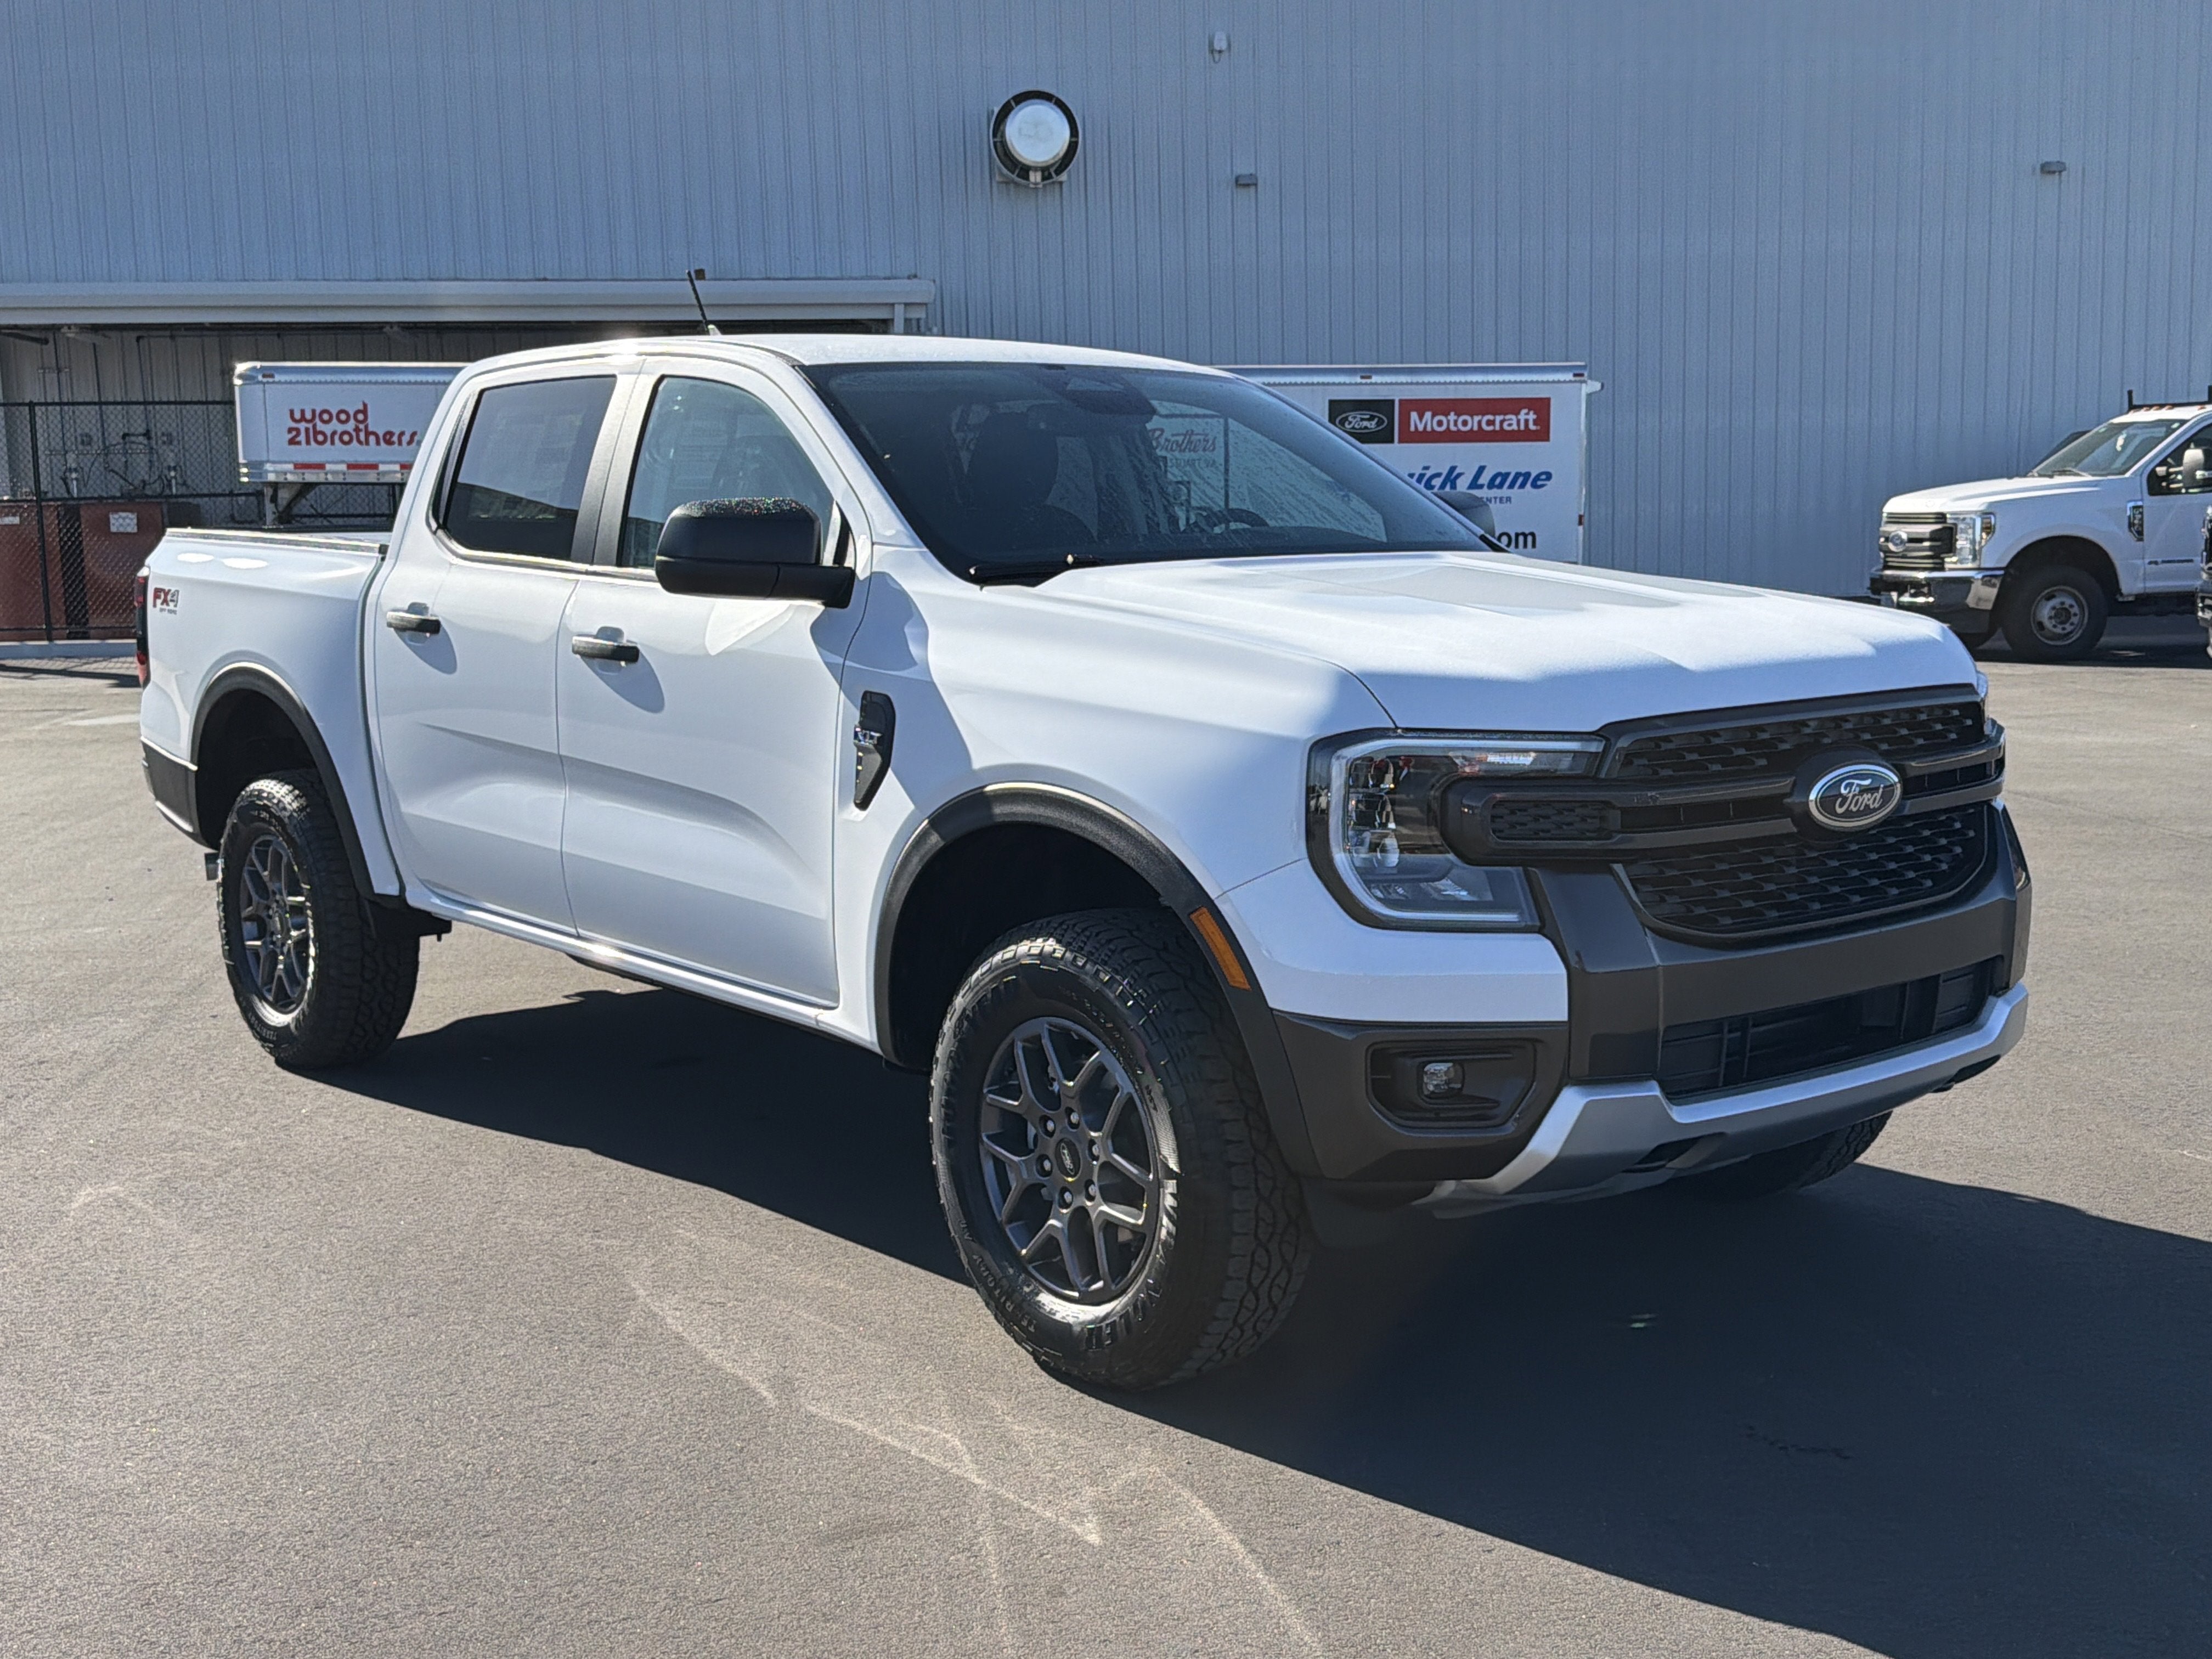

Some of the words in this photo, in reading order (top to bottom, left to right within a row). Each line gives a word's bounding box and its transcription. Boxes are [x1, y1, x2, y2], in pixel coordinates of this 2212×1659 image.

[289, 400, 368, 424] wood
[1345, 415, 1378, 428] Ford
[1149, 428, 1217, 453] Brothers
[1407, 465, 1465, 490] ick
[1466, 465, 1553, 489] Lane
[153, 587, 180, 608] FX4
[1835, 778, 1884, 814] Ford
